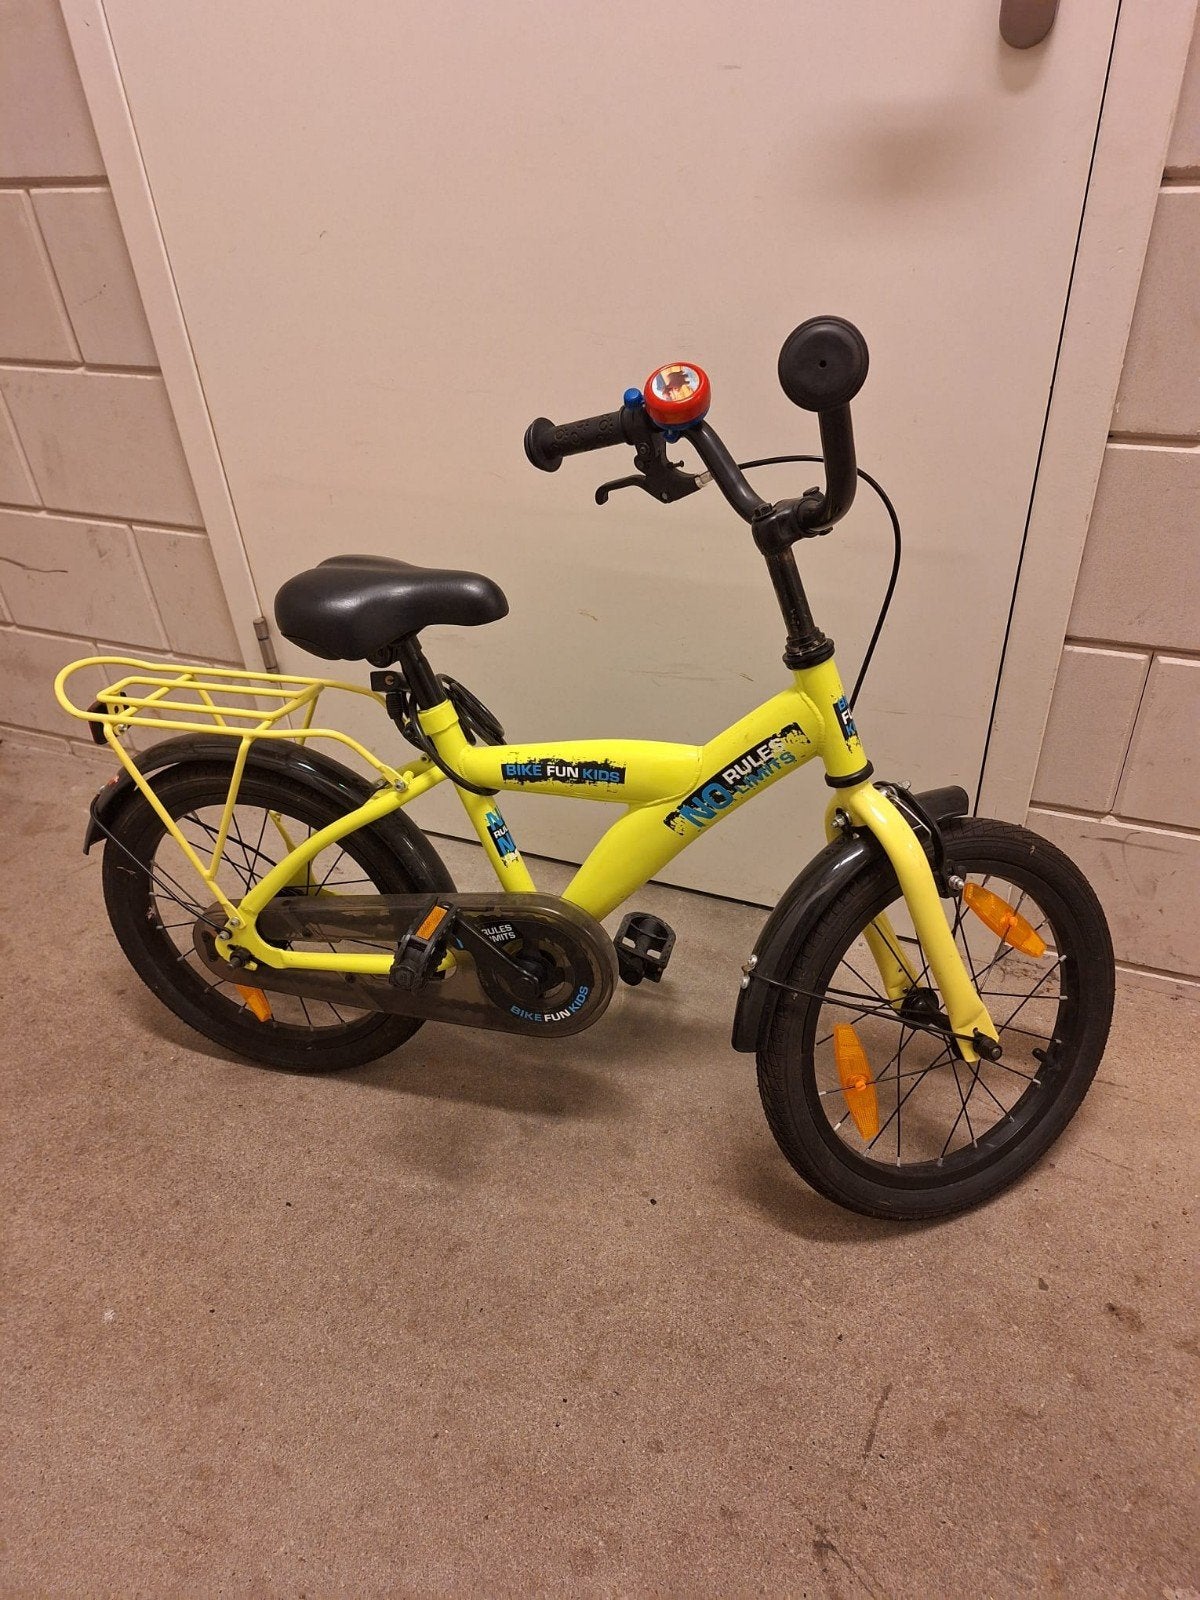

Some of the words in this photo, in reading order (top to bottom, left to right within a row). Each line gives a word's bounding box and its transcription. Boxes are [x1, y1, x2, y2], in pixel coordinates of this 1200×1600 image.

[506, 764, 542, 777] BIKE
[546, 765, 579, 779] FUN
[582, 767, 620, 783] KIDS
[680, 783, 734, 828] NO
[722, 737, 785, 785] RULES
[734, 751, 796, 794] LIMITS
[510, 1005, 542, 1022] BIKE
[543, 1009, 571, 1023] FUN
[568, 985, 589, 1013] KIDS
